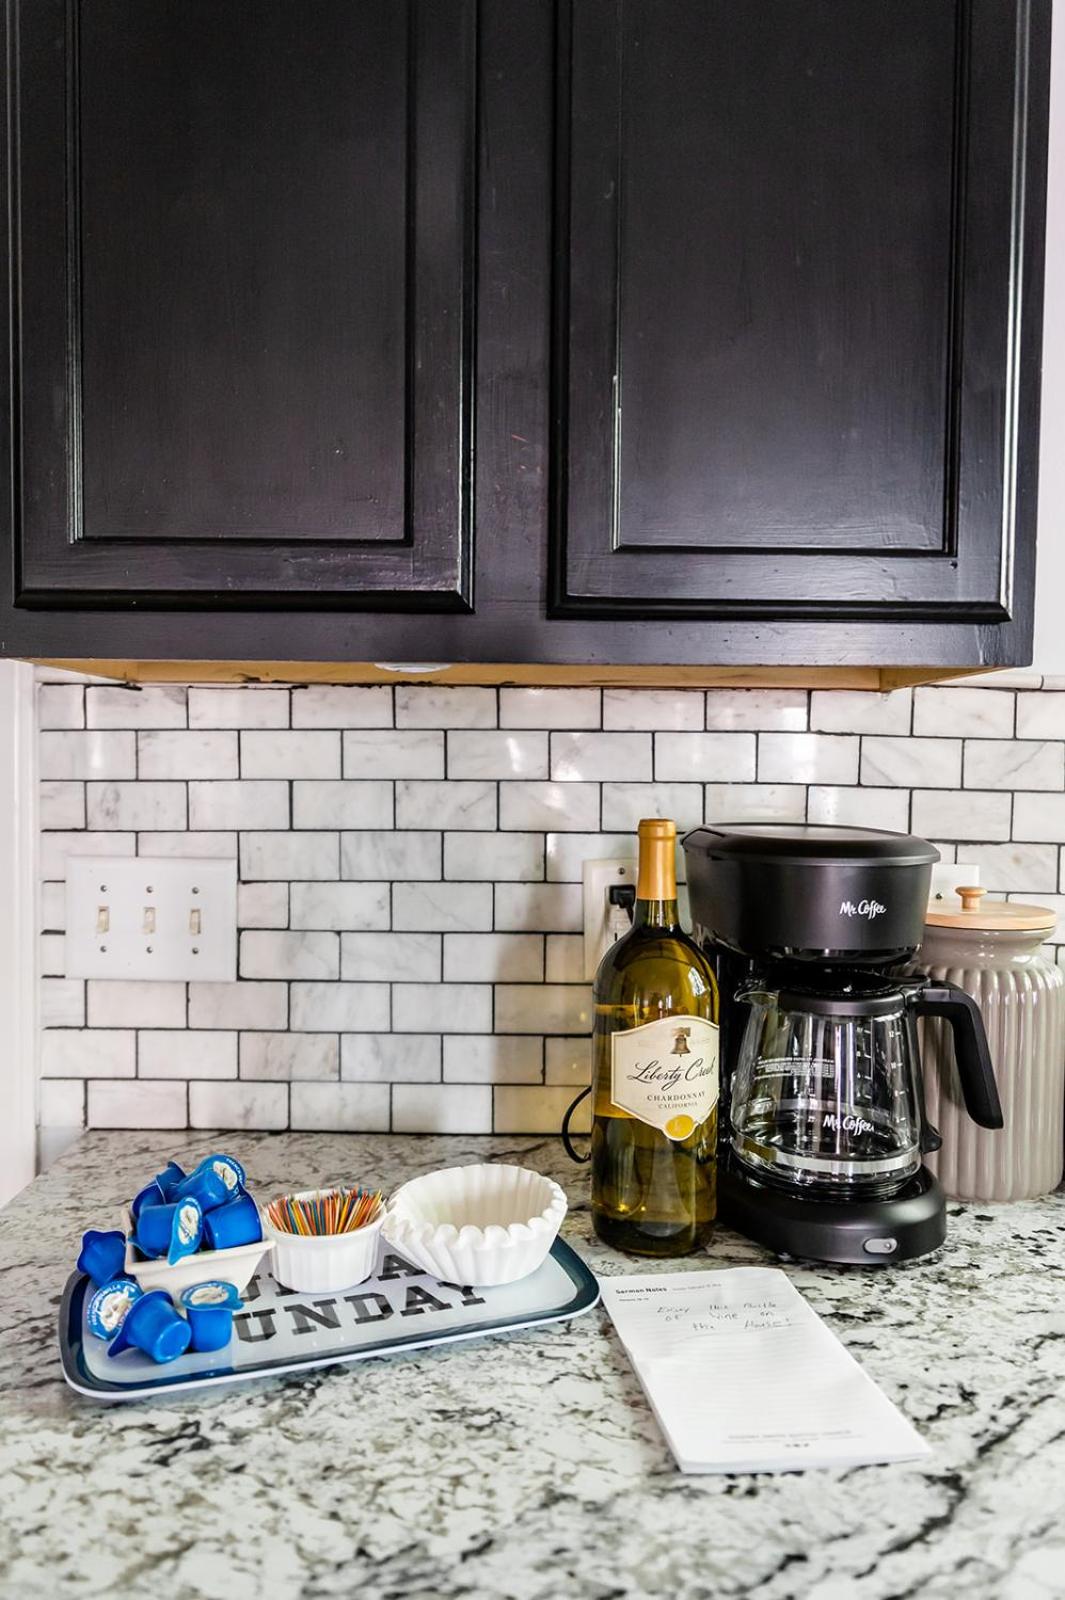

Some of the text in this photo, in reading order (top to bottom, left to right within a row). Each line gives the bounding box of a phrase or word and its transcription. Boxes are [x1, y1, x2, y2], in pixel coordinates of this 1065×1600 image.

[858, 899, 887, 920] Coffee
[626, 1060, 685, 1091] Liberty
[646, 1090, 706, 1103] CHARDONNAY
[658, 1101, 698, 1110] CALIFORNIA
[842, 1115, 873, 1136] Coffee
[231, 1279, 487, 1344] UNDAY
